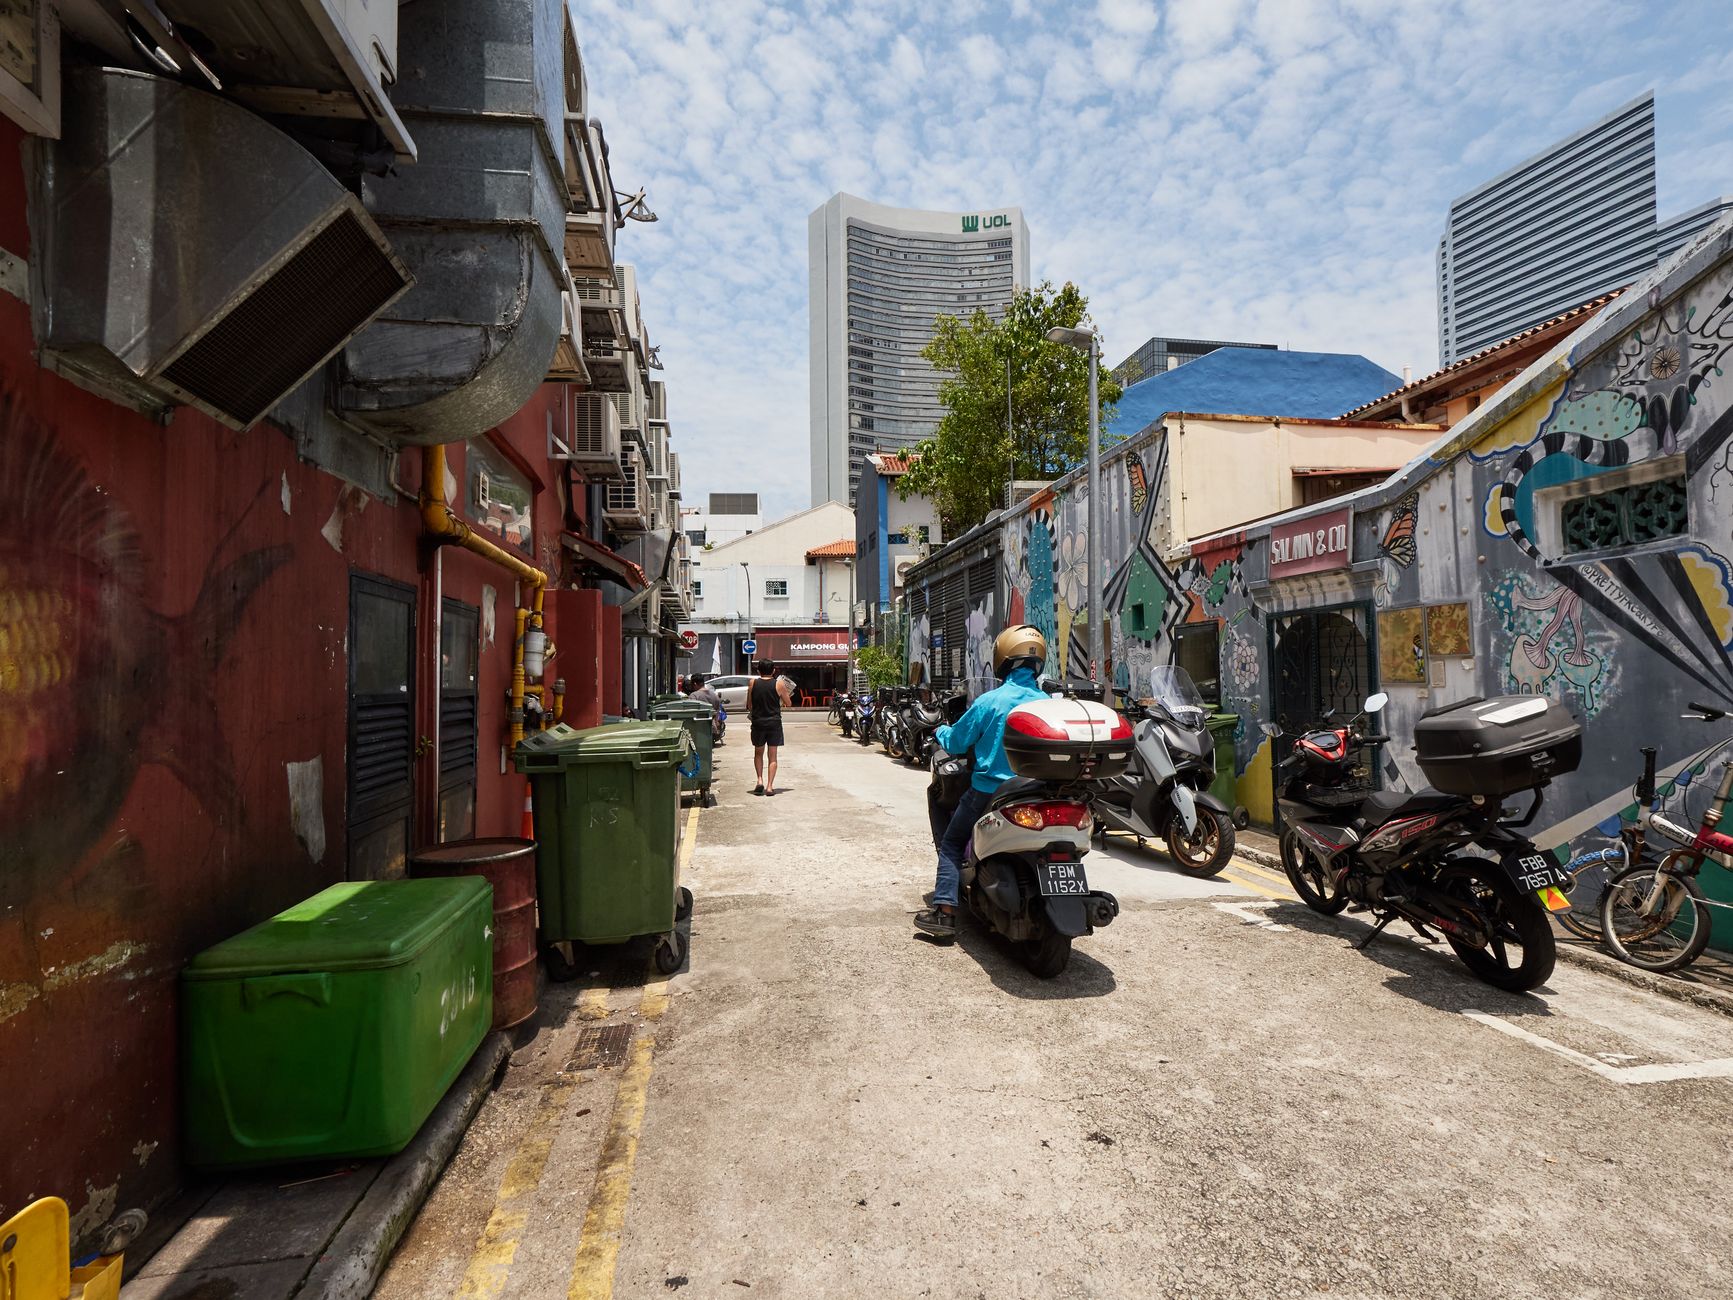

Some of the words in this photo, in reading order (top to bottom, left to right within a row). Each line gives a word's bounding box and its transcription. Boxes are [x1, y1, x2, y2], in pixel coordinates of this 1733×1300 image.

[982, 214, 1012, 229] UOL
[1315, 529, 1327, 556] &
[790, 643, 836, 651] KAMPONG
[1518, 854, 1548, 872] FBB
[1048, 865, 1076, 879] FBM
[1518, 869, 1554, 890] 7657
[1554, 867, 1568, 882] A
[1047, 880, 1086, 893] 1152X
